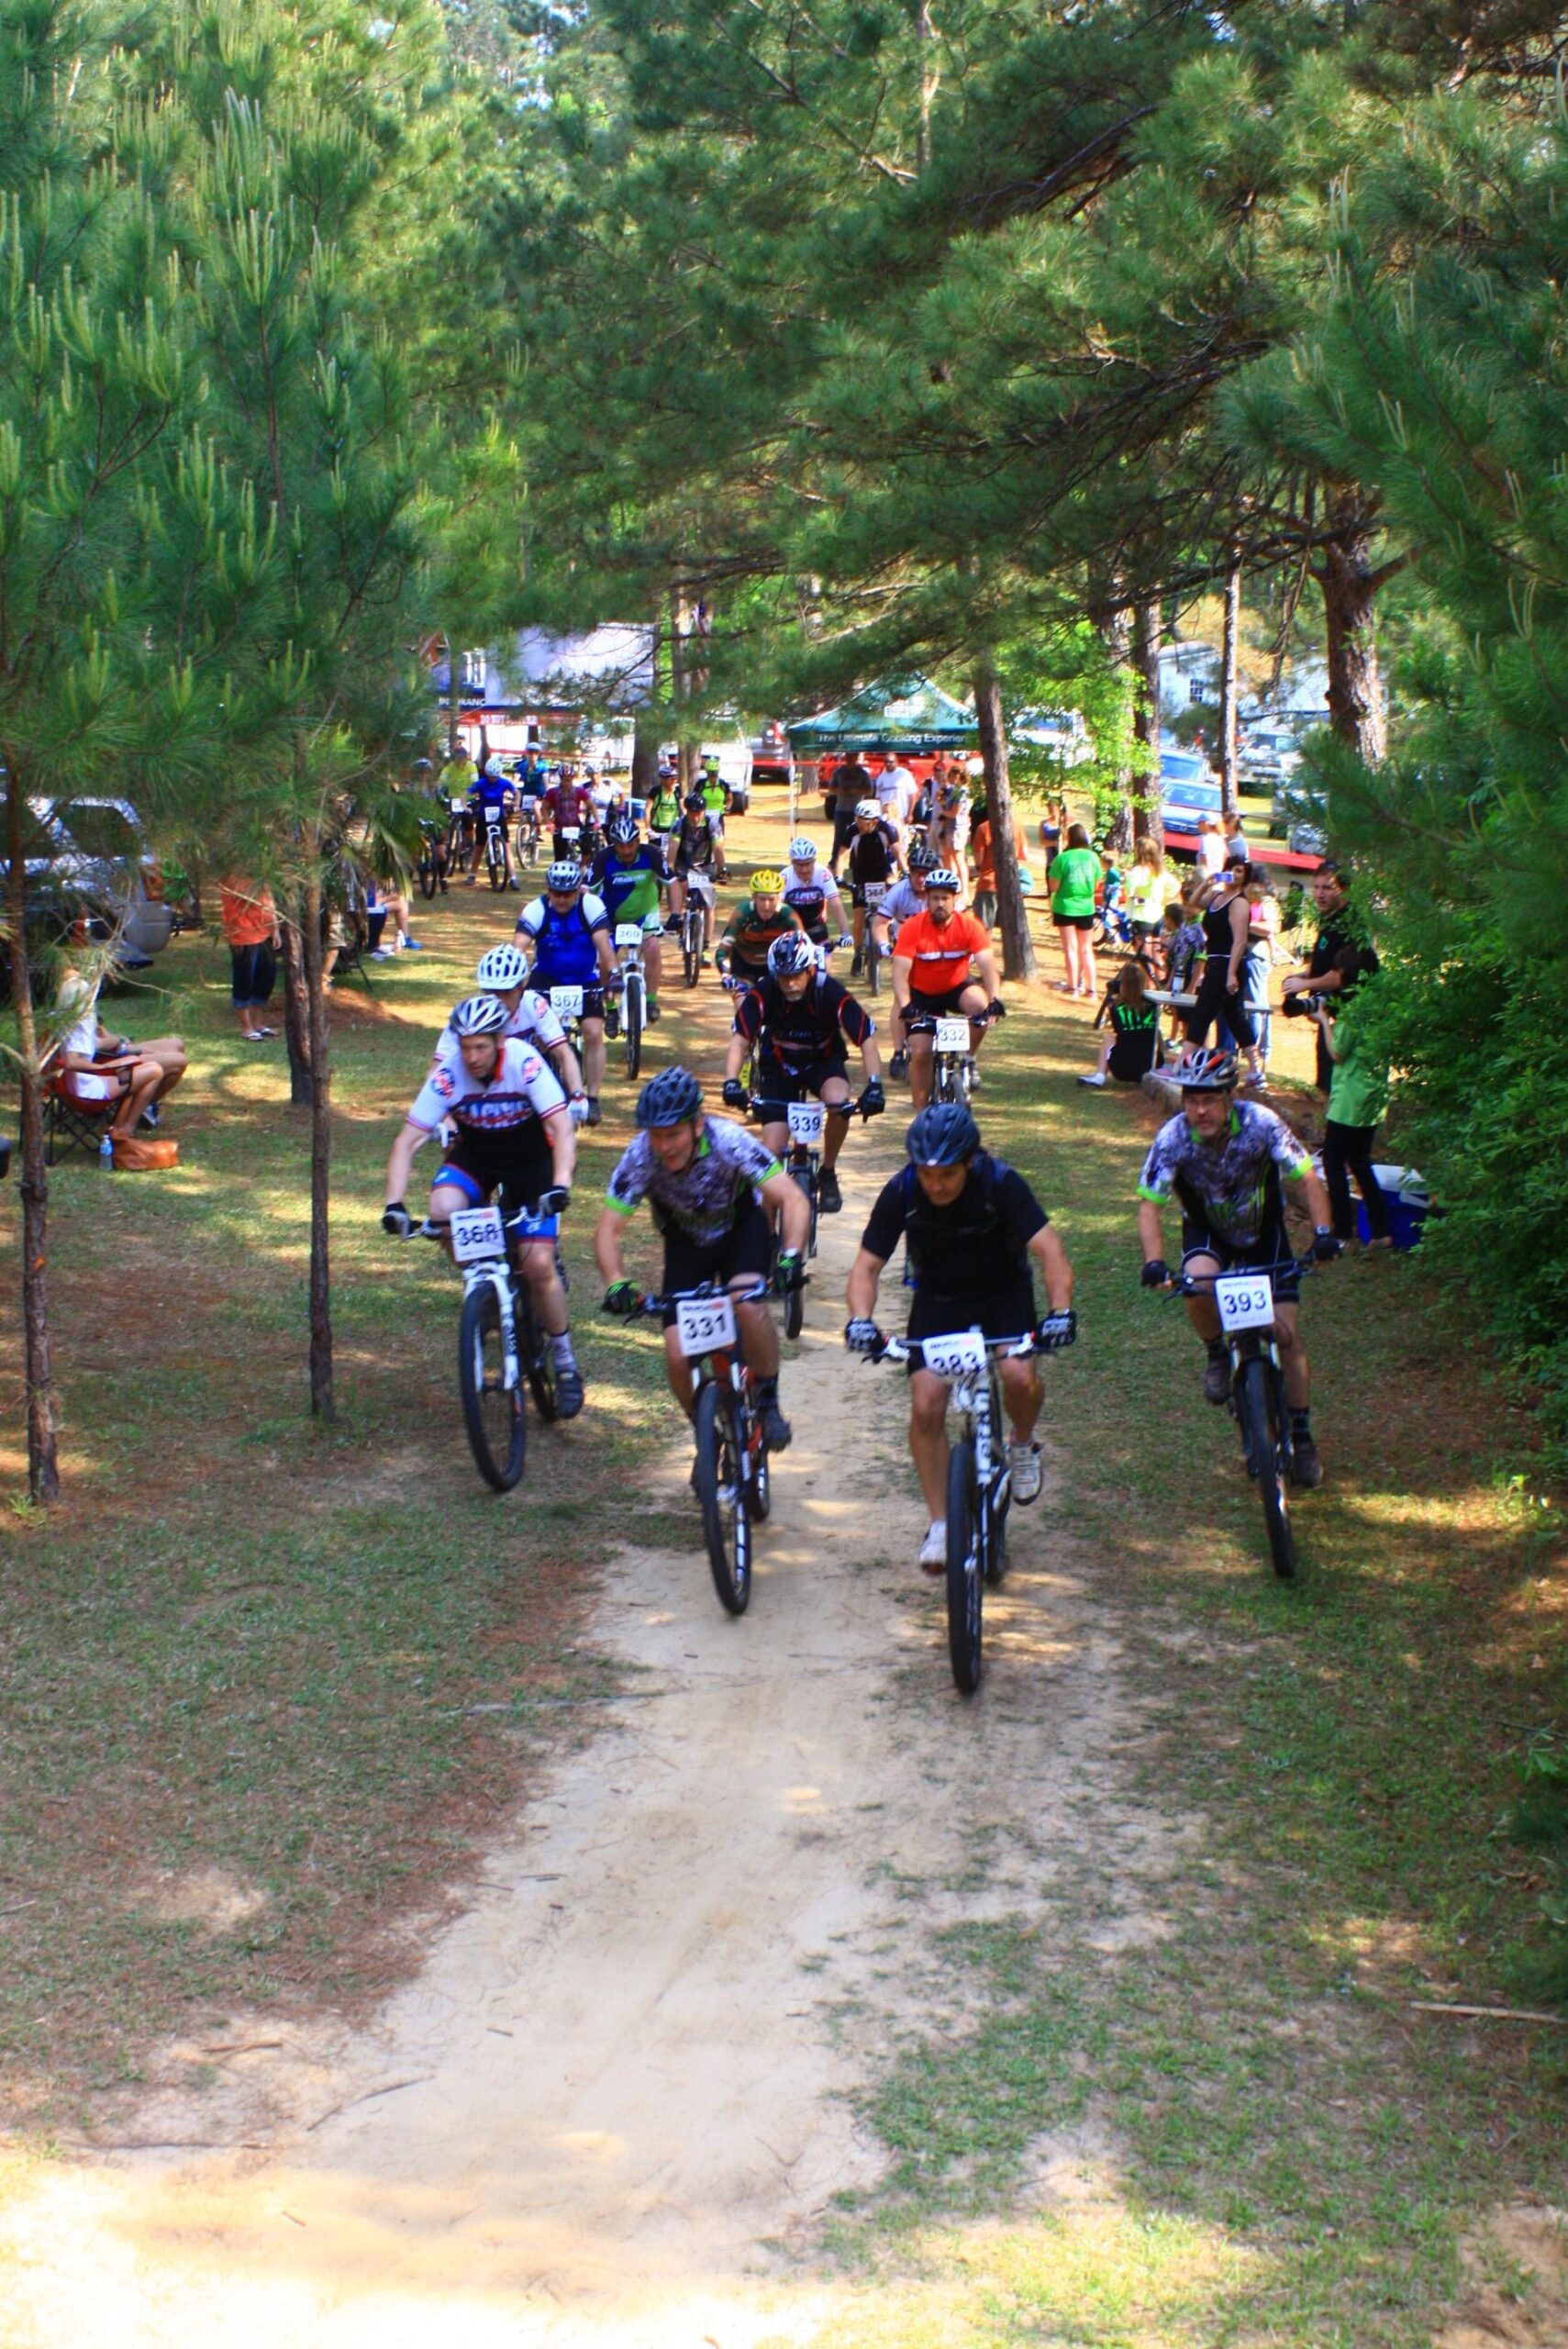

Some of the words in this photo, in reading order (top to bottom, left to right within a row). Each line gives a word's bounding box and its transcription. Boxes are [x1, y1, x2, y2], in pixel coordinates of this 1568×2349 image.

[818, 734, 837, 742] The
[838, 733, 878, 742] Ultimate
[554, 995, 580, 1007] 367
[940, 1029, 966, 1041] 332
[791, 1116, 820, 1132] 339
[458, 1224, 497, 1246] 368
[1224, 1290, 1266, 1314] 393
[684, 1313, 727, 1340] 331
[933, 1353, 978, 1375] 383
